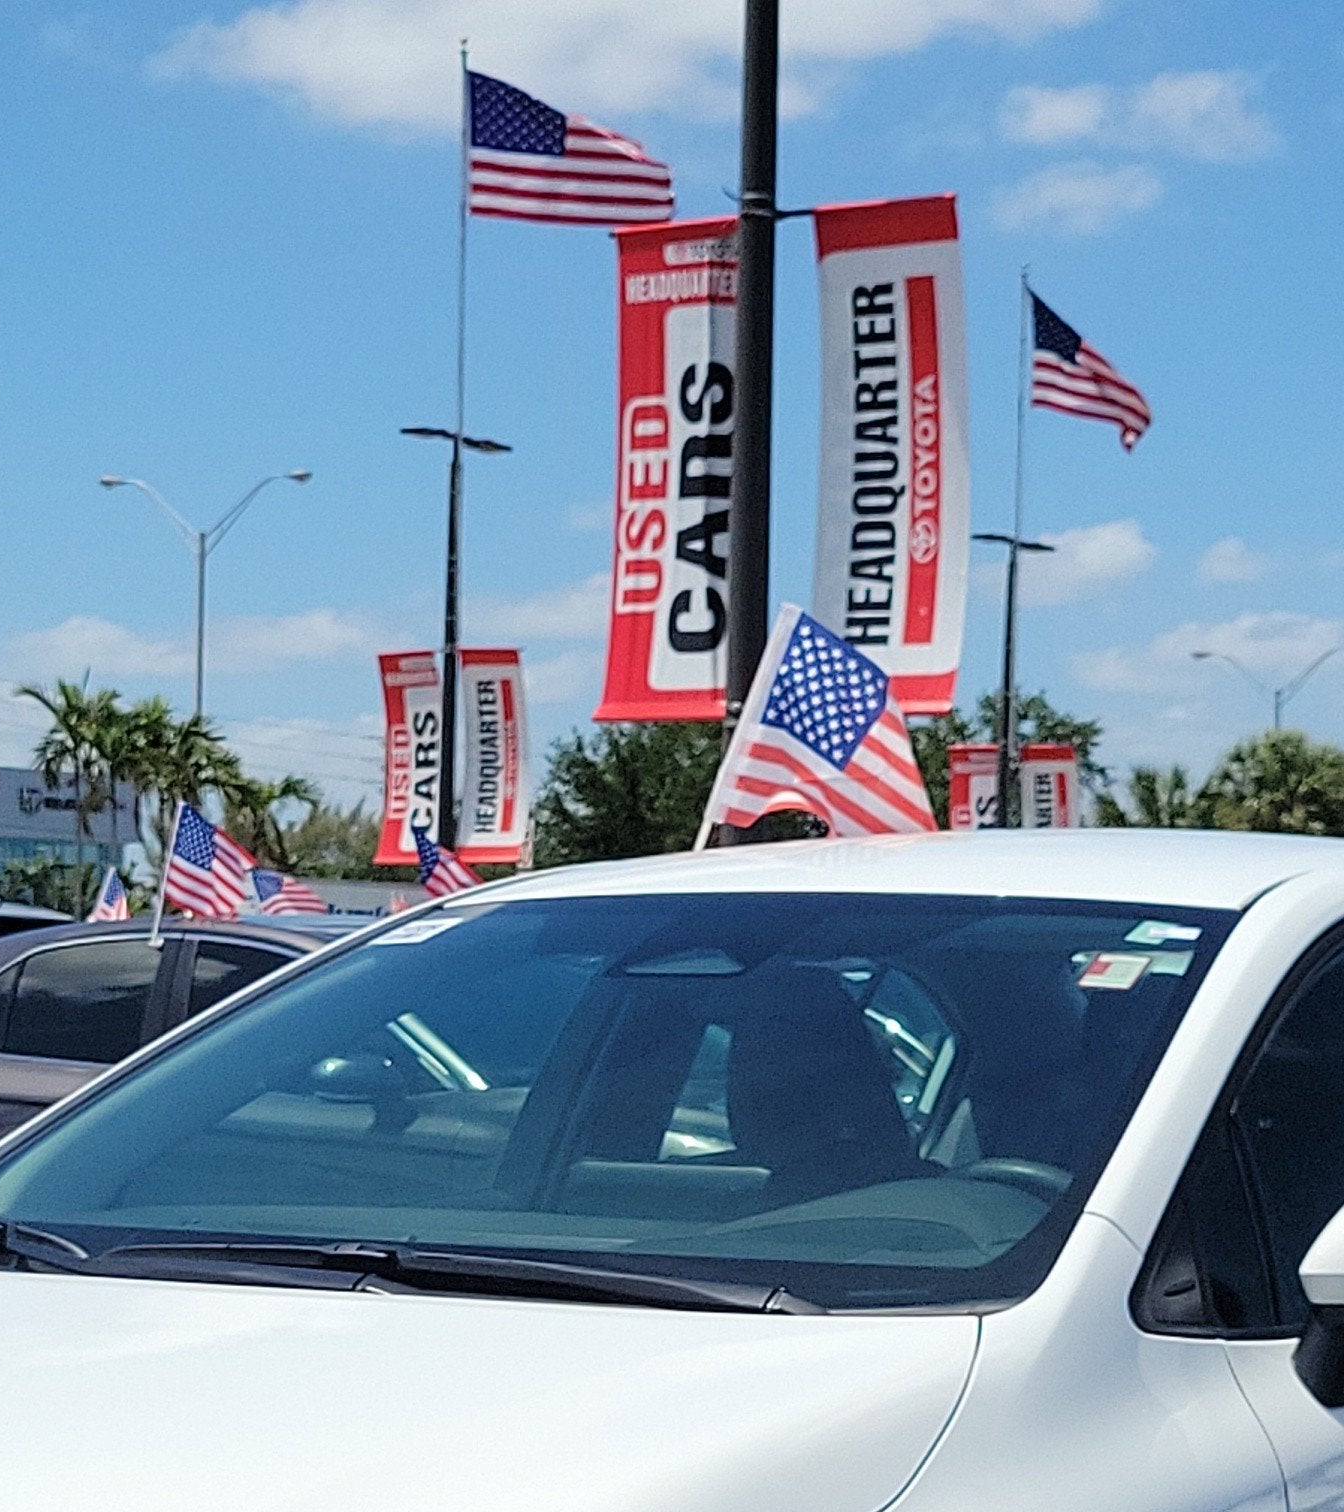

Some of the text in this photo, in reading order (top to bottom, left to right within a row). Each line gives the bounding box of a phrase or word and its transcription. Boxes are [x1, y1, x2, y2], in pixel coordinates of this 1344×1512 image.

[624, 404, 670, 610] USED
[669, 362, 735, 652] CARS
[844, 282, 905, 645] HEADQUARTER
[913, 373, 939, 518] TOYOTA
[392, 727, 409, 816] USED
[411, 710, 439, 831] CARS
[474, 679, 502, 833] HEADQUARTER
